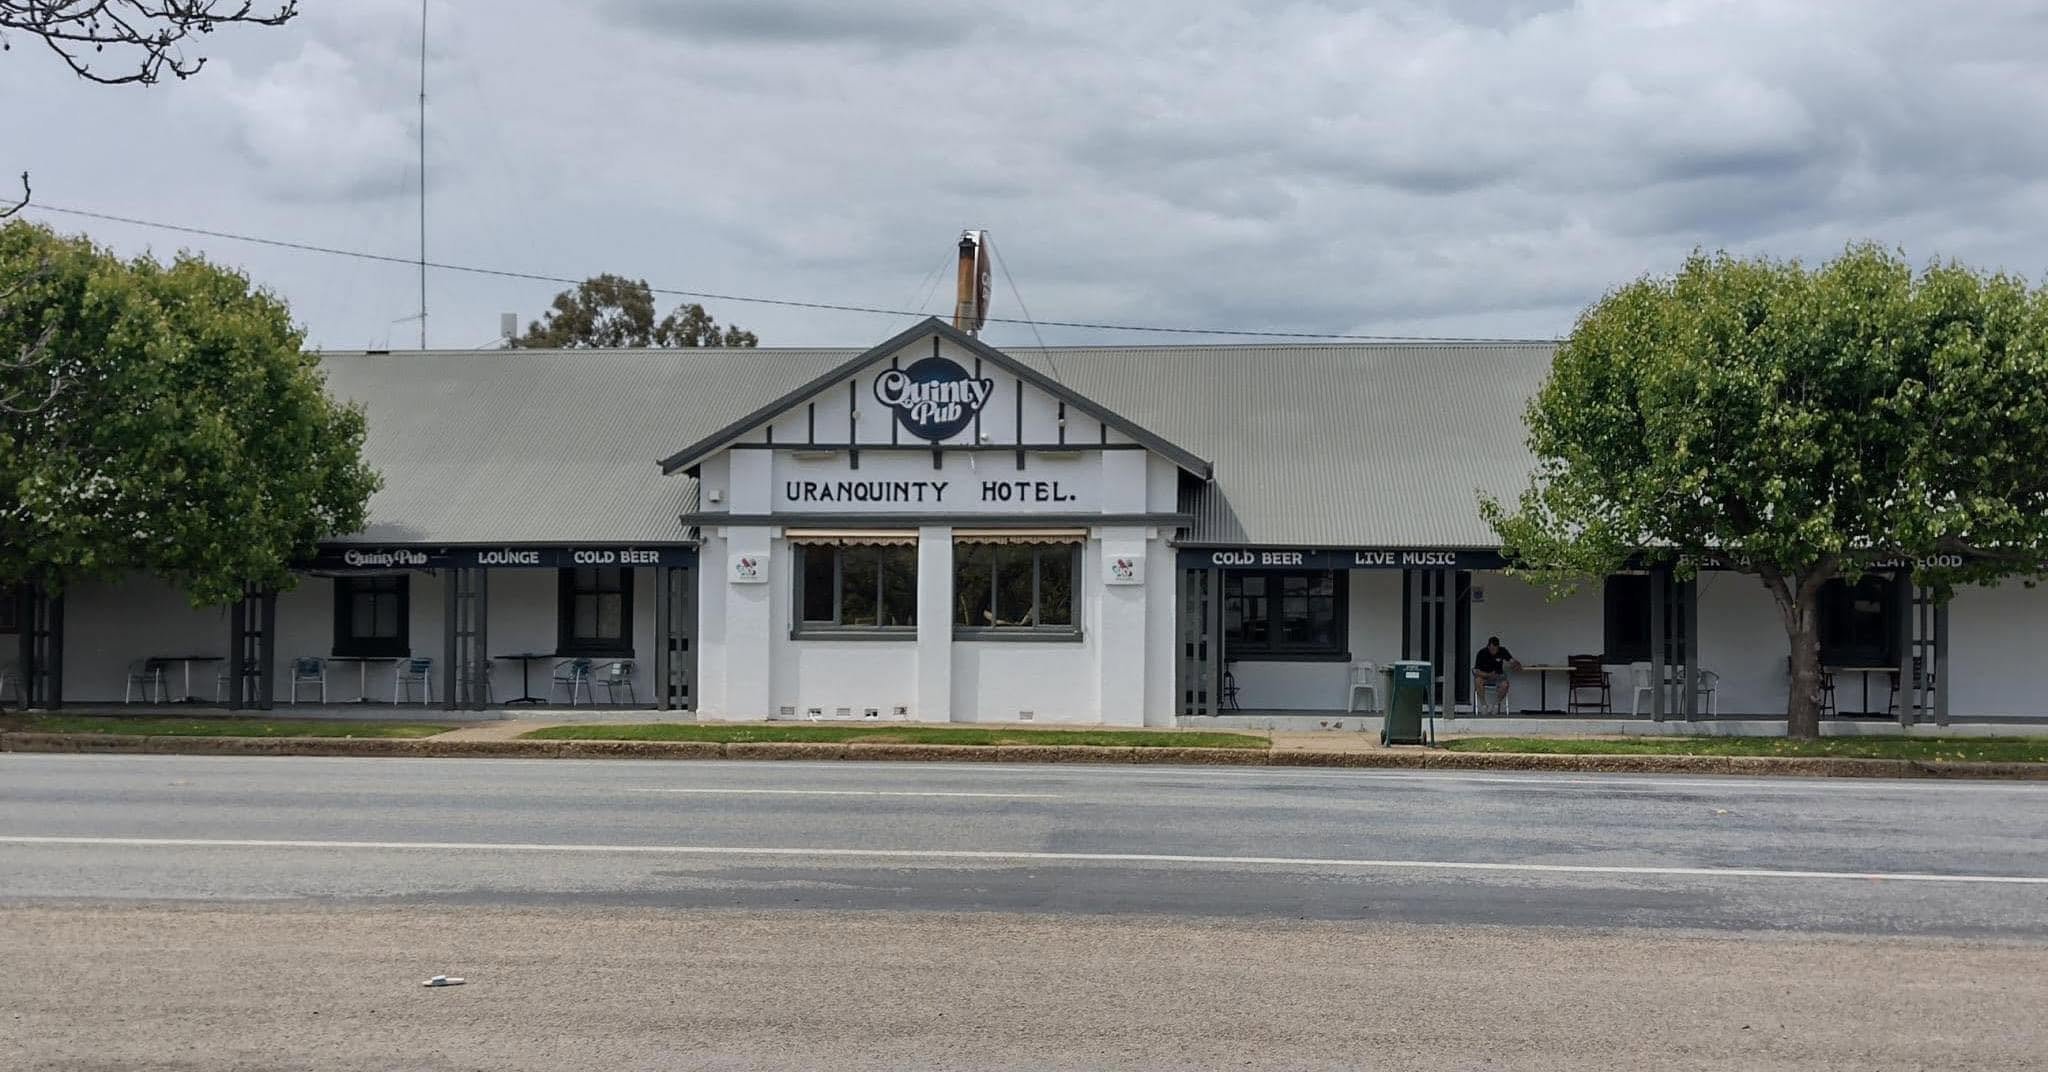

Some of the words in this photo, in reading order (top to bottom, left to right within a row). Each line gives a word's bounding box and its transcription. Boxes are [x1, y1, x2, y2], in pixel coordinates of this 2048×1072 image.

[875, 370, 992, 410] Quinty
[910, 399, 962, 426] Pub
[785, 481, 949, 502] URANQUINTY
[981, 480, 1077, 502] HOTEL.
[344, 549, 394, 567] Quinty
[394, 549, 428, 565] Pub
[478, 551, 540, 565] LOUNGE
[573, 550, 616, 564] COLD
[619, 550, 660, 564] BEER
[1211, 551, 1256, 566] COLD
[1261, 552, 1303, 566] BEER
[1354, 552, 1396, 565] LIVE
[1401, 552, 1457, 566] MUSIC
